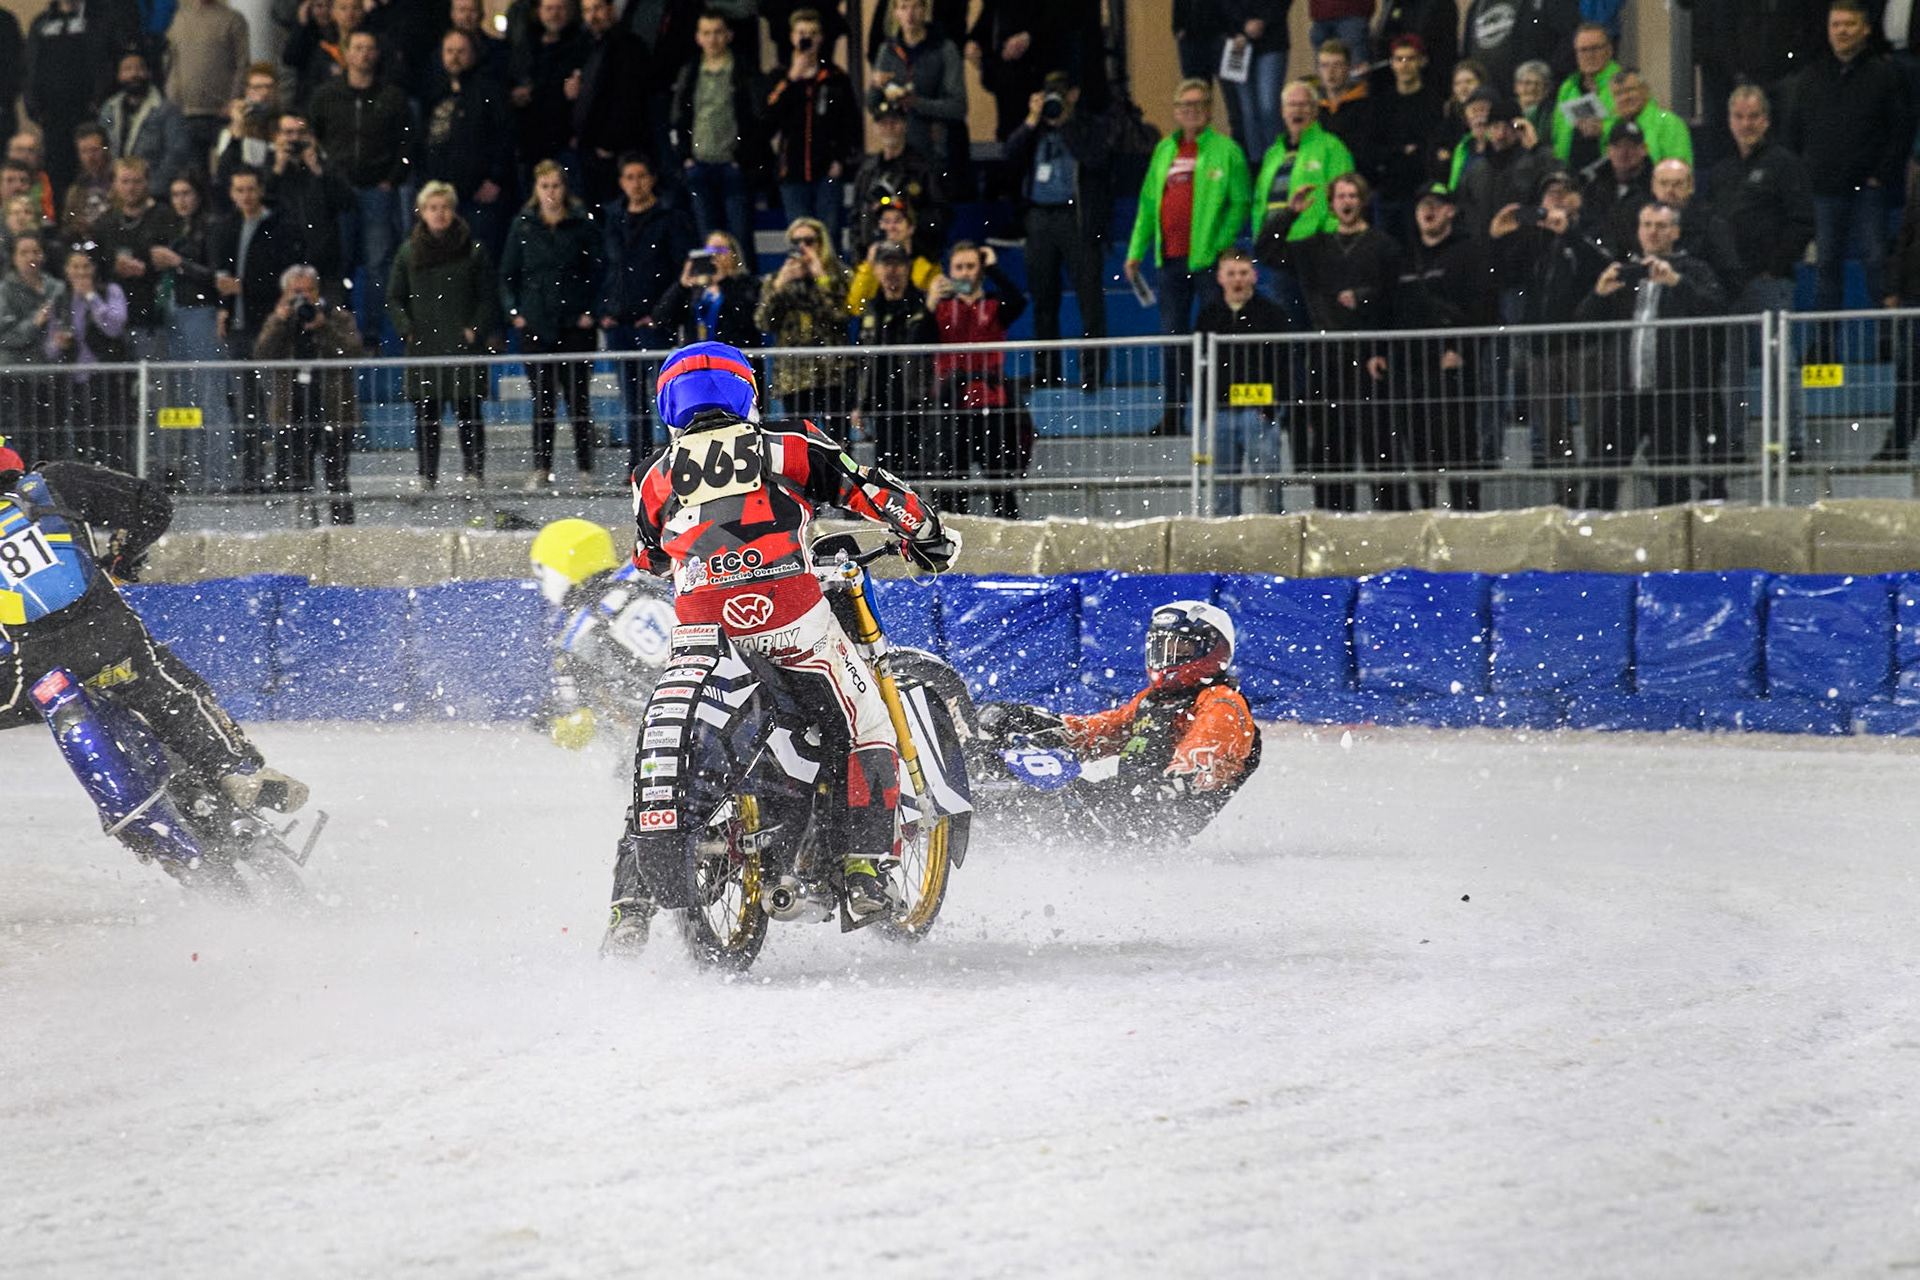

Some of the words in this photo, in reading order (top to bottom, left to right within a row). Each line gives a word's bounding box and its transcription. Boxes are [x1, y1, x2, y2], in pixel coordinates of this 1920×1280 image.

[672, 432, 761, 496] 665
[0, 530, 52, 578] 81
[709, 548, 763, 574] ECO
[641, 811, 676, 827] ECO
